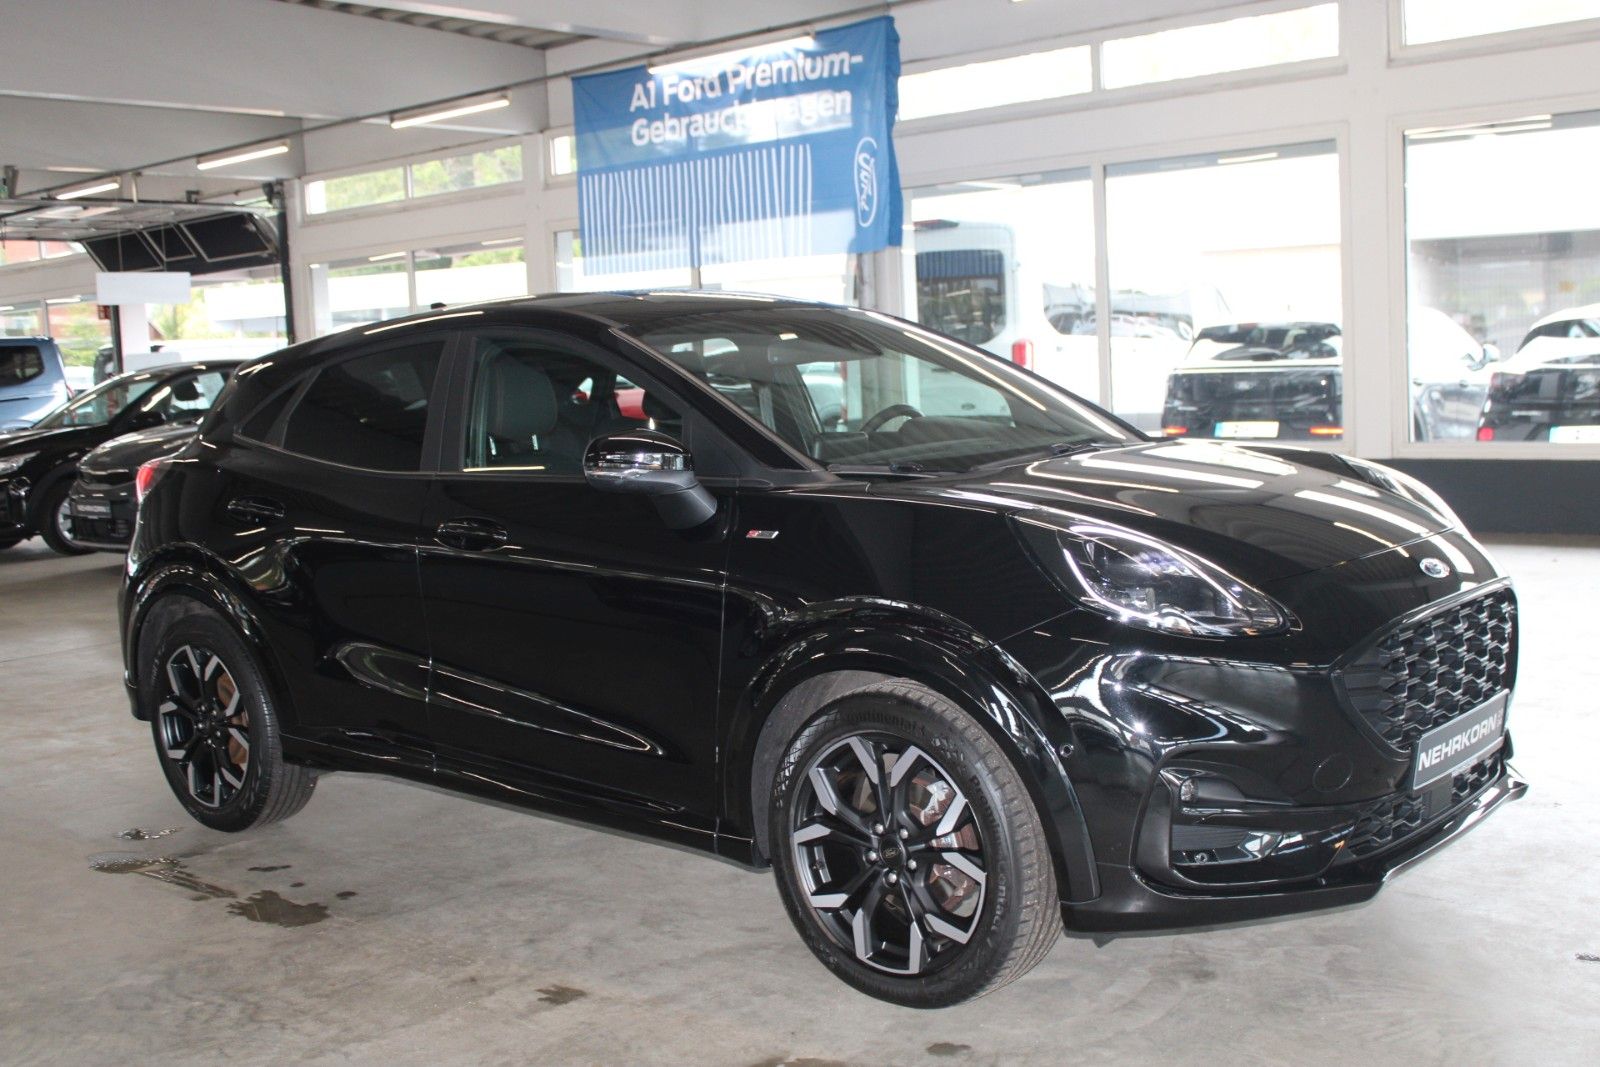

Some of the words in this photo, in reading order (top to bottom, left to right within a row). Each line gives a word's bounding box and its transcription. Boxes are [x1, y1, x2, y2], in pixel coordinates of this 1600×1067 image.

[629, 82, 656, 112] A1
[662, 70, 722, 105] Ford
[726, 51, 863, 92] Premium-
[631, 89, 852, 146] Gebrauchagen
[1418, 713, 1497, 771] NEHRKORN
